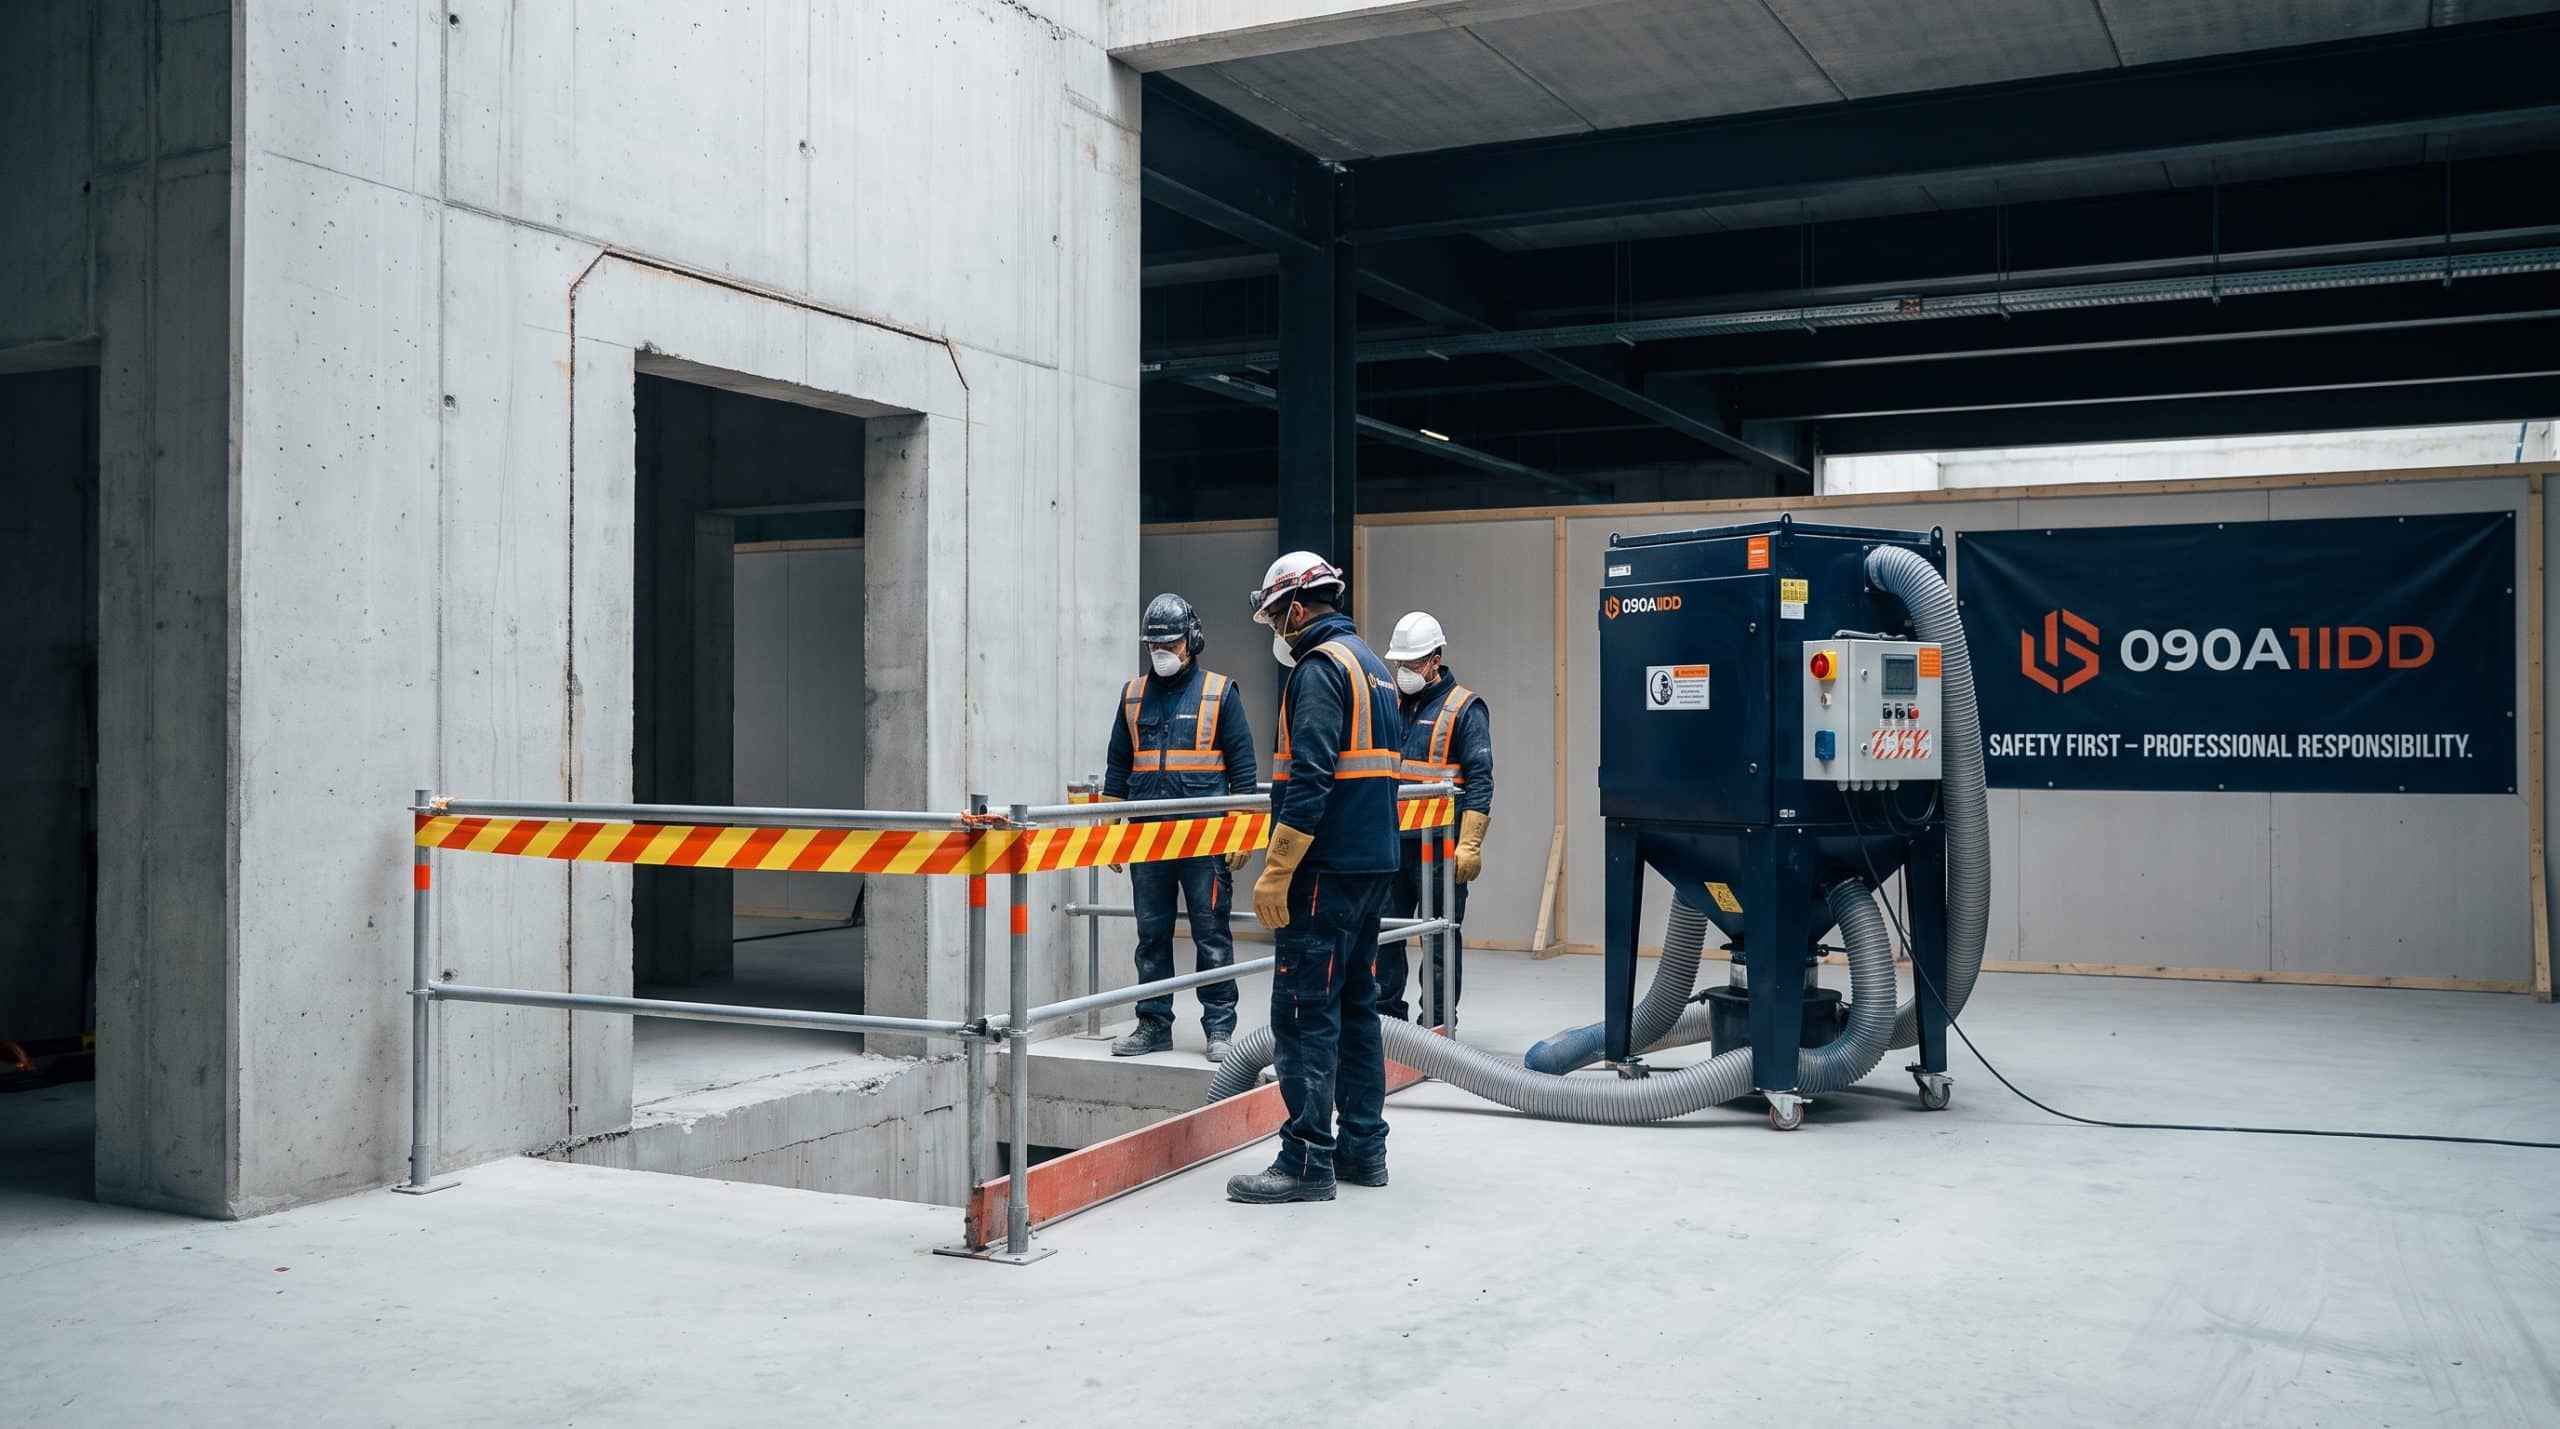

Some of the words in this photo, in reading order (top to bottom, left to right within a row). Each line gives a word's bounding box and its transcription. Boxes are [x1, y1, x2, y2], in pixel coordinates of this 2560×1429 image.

[1989, 733, 2062, 757] SAFETY
[2066, 733, 2121, 757] FIRST
[2143, 733, 2293, 758] PROFESSIONAL
[2297, 733, 2473, 758] RESPONSIBILITY.
